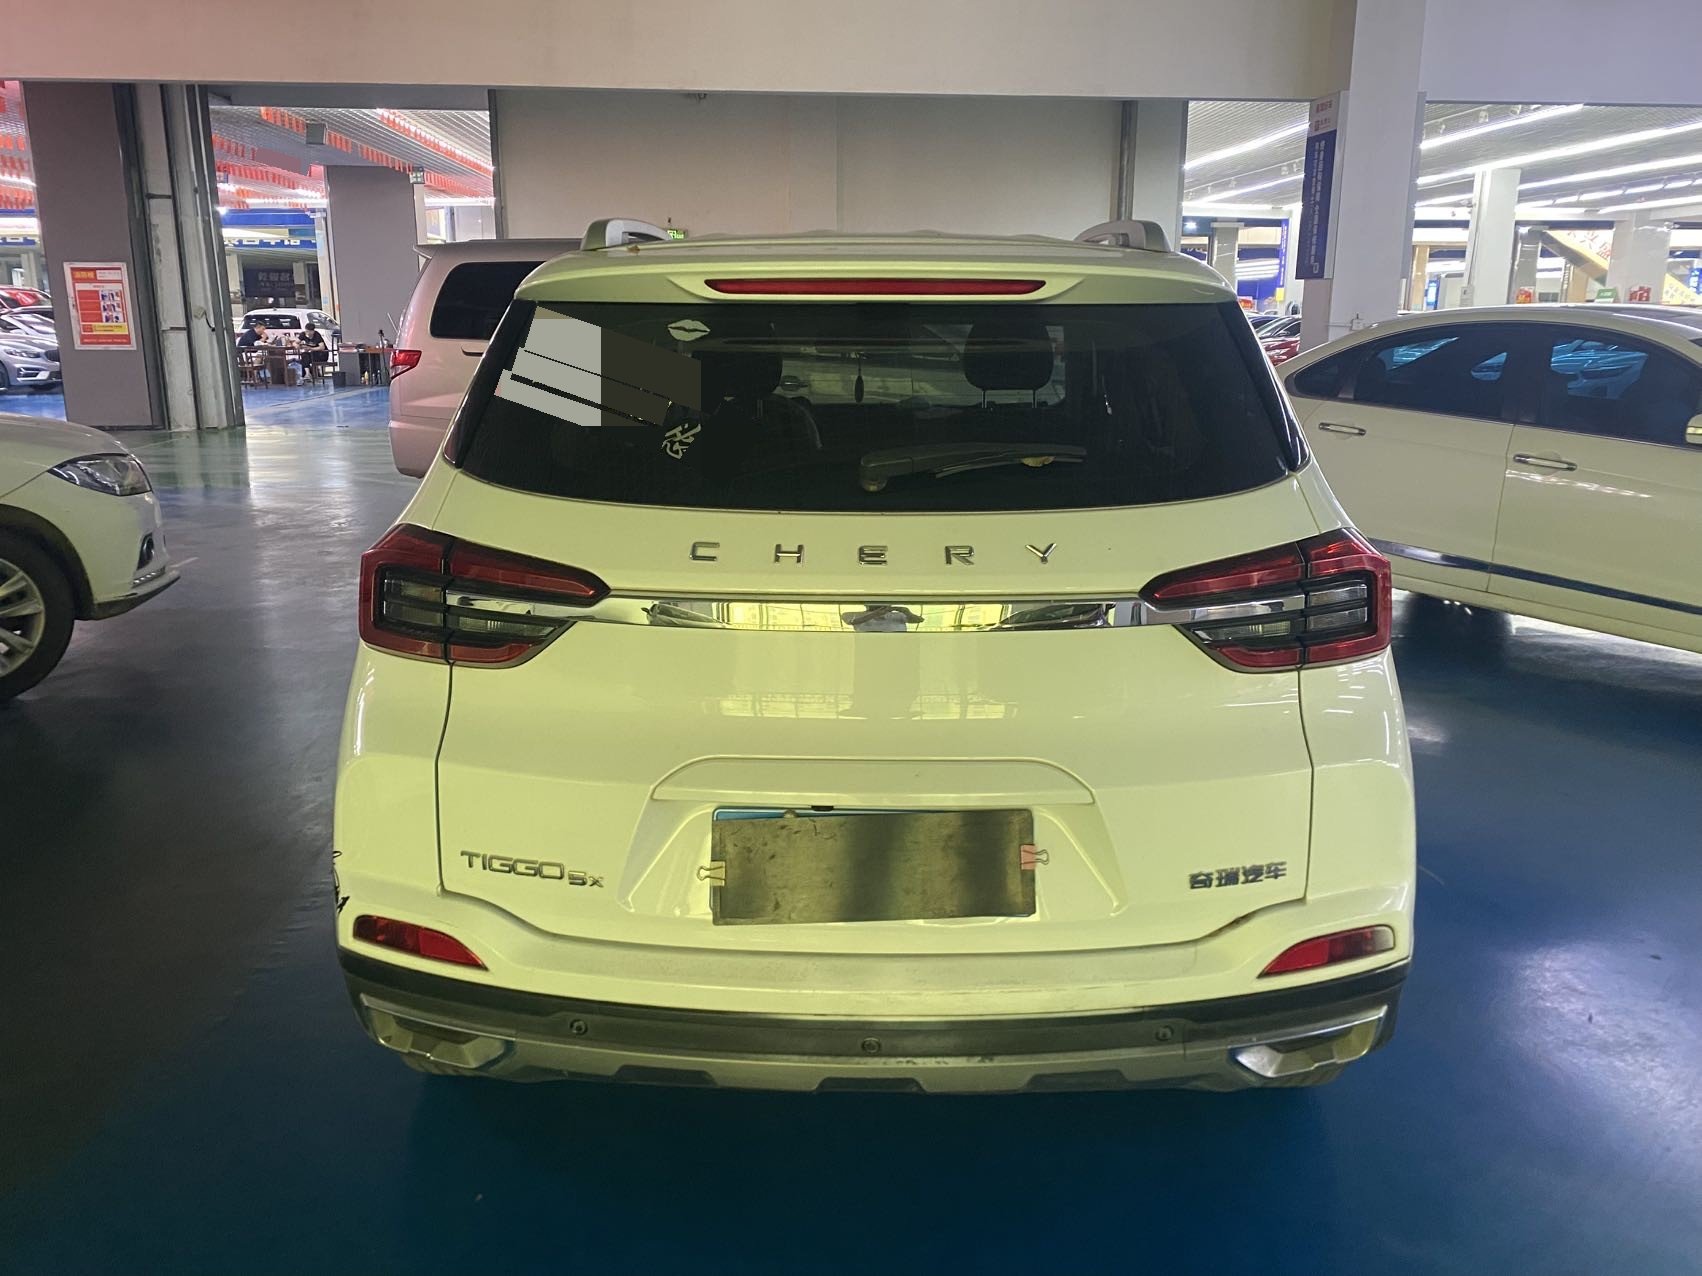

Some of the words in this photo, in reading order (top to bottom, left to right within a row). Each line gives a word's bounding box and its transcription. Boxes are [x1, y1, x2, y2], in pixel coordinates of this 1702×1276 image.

[689, 541, 1057, 565] CHERY
[460, 850, 564, 880] TIGGO
[1189, 861, 1287, 889] 奇瑞汽车
